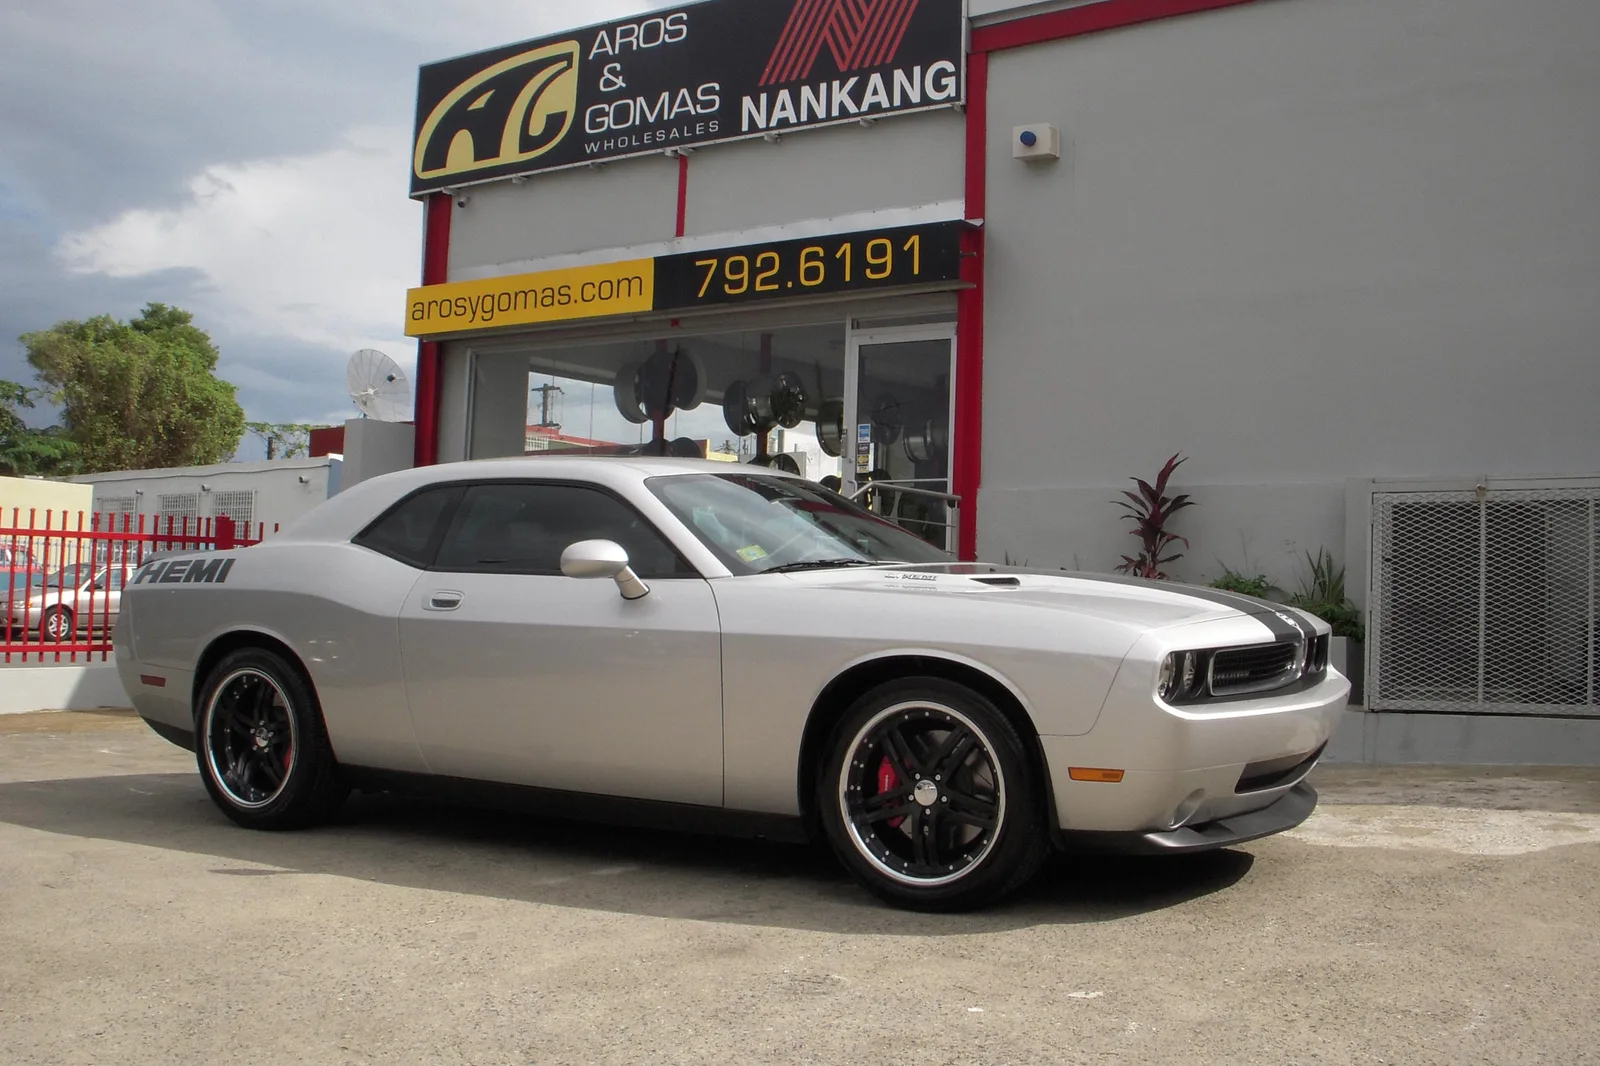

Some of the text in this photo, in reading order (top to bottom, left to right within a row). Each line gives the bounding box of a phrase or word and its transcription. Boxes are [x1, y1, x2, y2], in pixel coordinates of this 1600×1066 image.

[588, 12, 688, 60] AROS
[599, 62, 626, 92] &
[741, 60, 956, 132] NANKANG
[585, 82, 720, 134] GOMAS
[584, 120, 719, 154] WHOLESALES
[695, 234, 920, 298] 792.6191
[411, 275, 643, 323] arosygomas.com
[133, 558, 236, 584] HEMI
